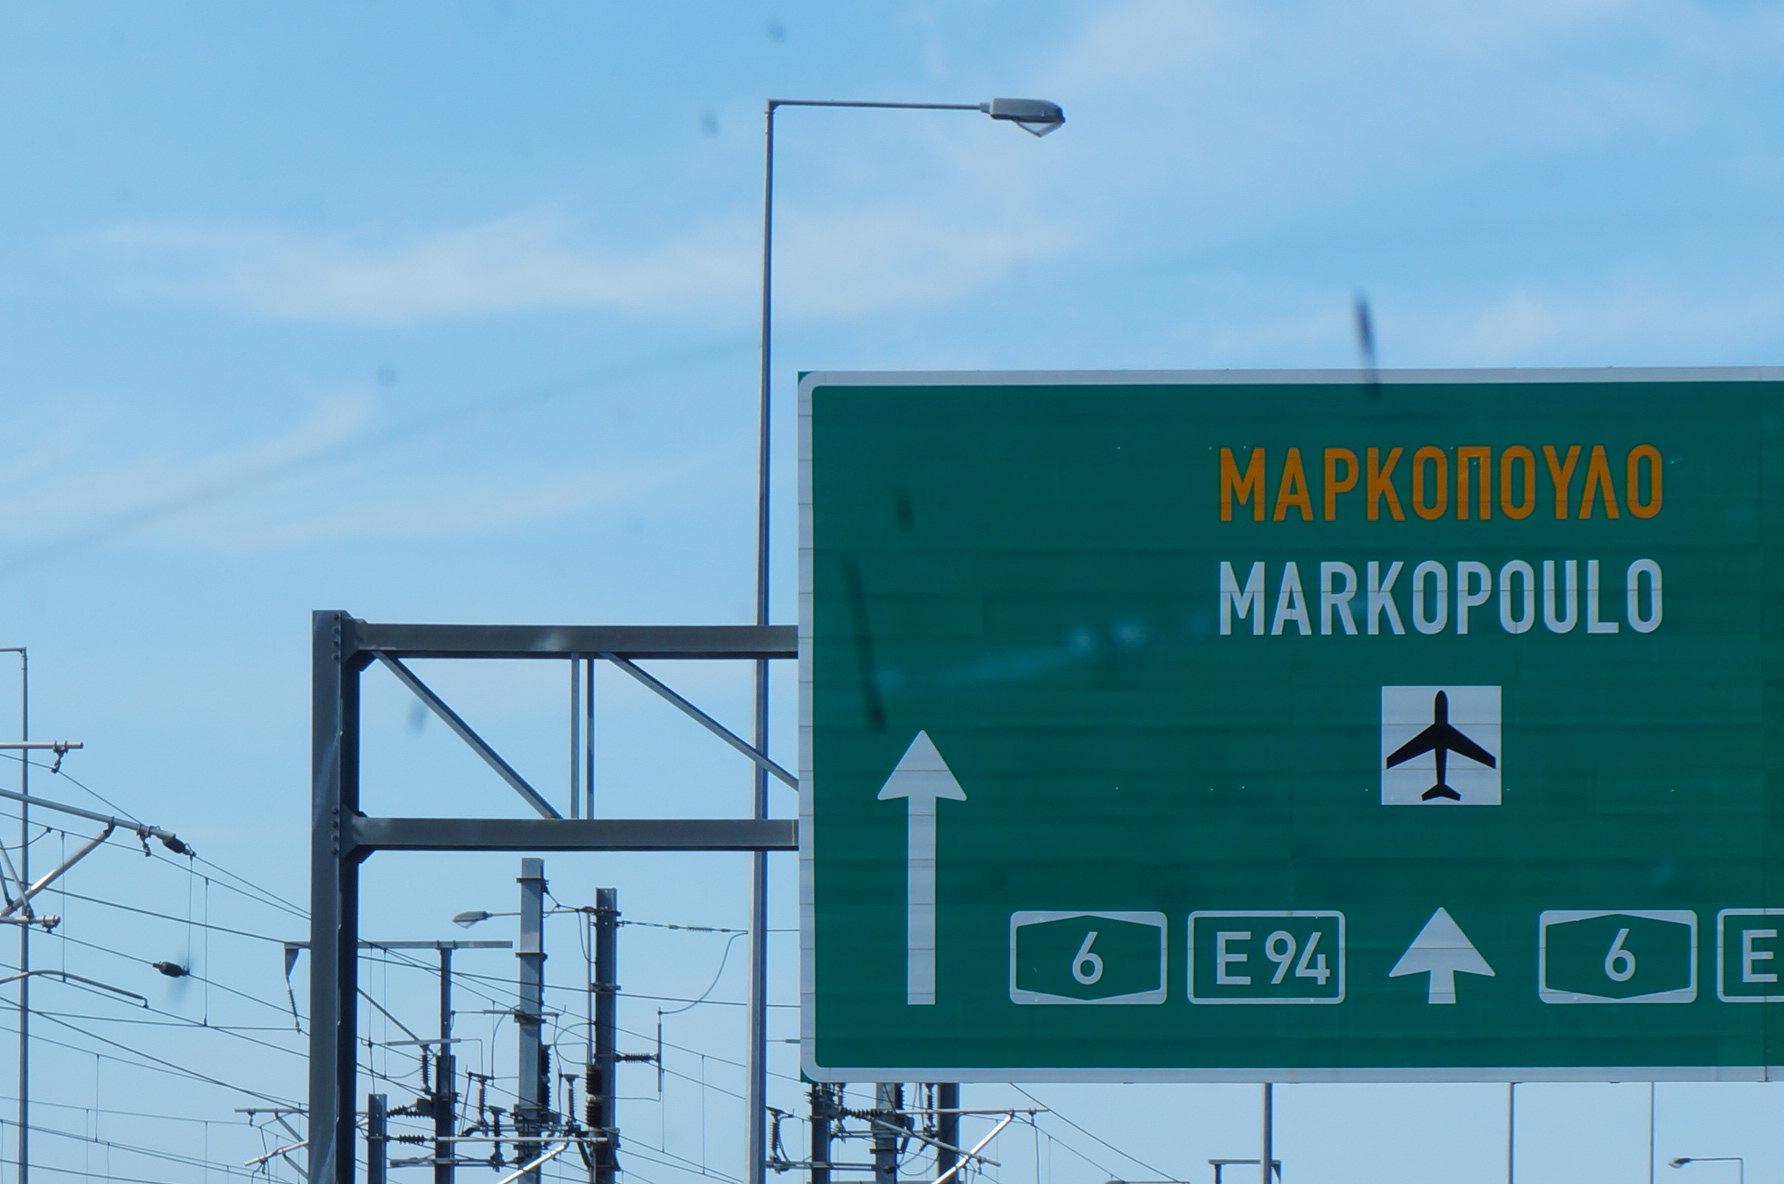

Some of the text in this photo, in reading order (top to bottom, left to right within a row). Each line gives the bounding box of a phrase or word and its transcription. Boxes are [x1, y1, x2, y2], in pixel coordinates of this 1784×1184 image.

[1219, 444, 1664, 522] ΜΑΡΚΟΠΟΥΛΟ
[1219, 558, 1664, 636] MARKOPOULO
[1071, 930, 1105, 985] 6
[1216, 929, 1332, 986] E 94
[1603, 927, 1637, 982] 6
[1742, 928, 1779, 984] E
